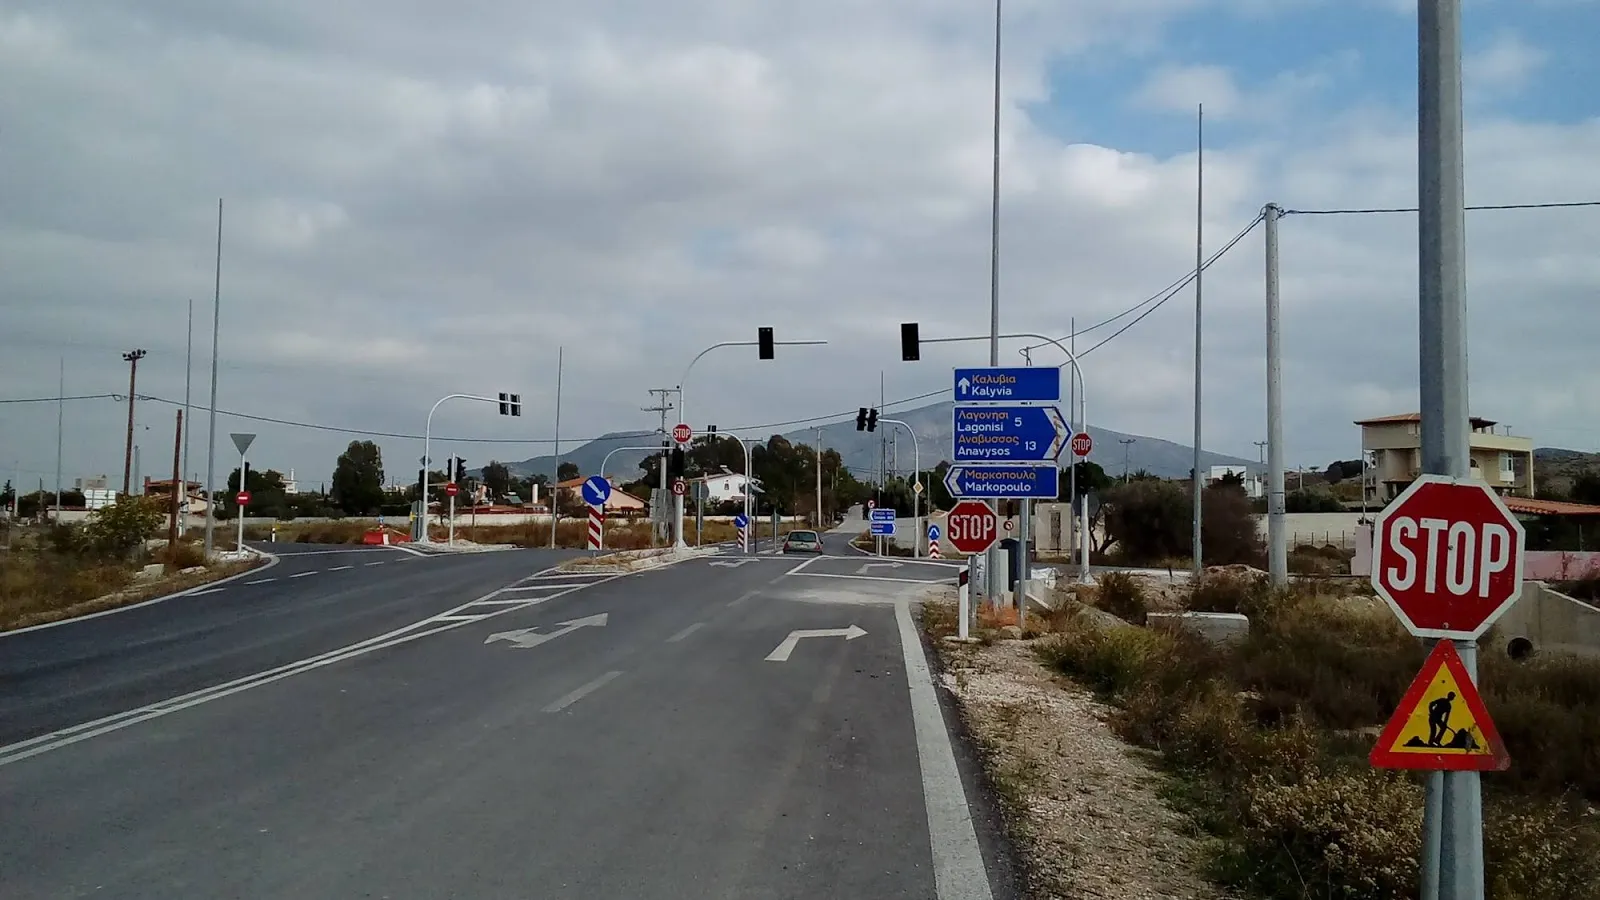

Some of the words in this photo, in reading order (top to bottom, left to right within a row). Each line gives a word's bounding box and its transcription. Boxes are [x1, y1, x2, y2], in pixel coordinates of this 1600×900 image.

[972, 386, 1012, 398] Kalyvia
[957, 422, 1003, 433] Lagonisi
[1014, 417, 1022, 427] 5
[673, 428, 691, 438] STOP
[1025, 441, 1037, 451] 13
[1072, 438, 1091, 451] STOP
[957, 447, 1010, 458] Anavysos
[965, 482, 1031, 494] Markopoulo
[949, 514, 993, 540] STOP
[1387, 515, 1511, 598] STOP
